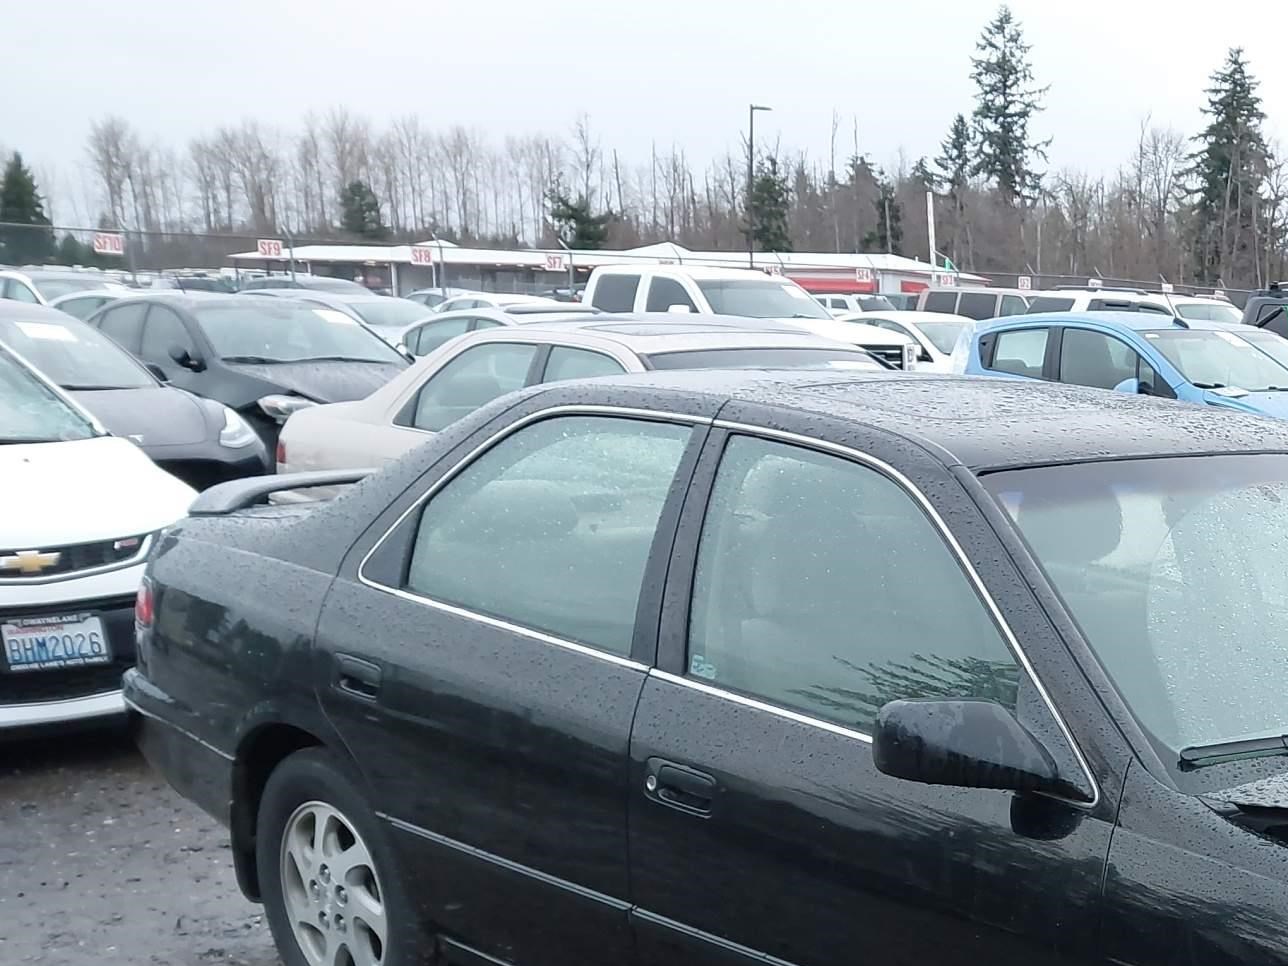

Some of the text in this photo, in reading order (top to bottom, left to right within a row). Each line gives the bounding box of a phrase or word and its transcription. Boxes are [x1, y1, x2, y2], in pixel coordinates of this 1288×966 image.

[94, 234, 121, 251] SF10
[259, 241, 281, 256] SF9
[411, 250, 431, 263] SF8
[547, 255, 563, 269] SF7
[857, 270, 870, 281] SF4
[8, 632, 102, 663] BHM2026
